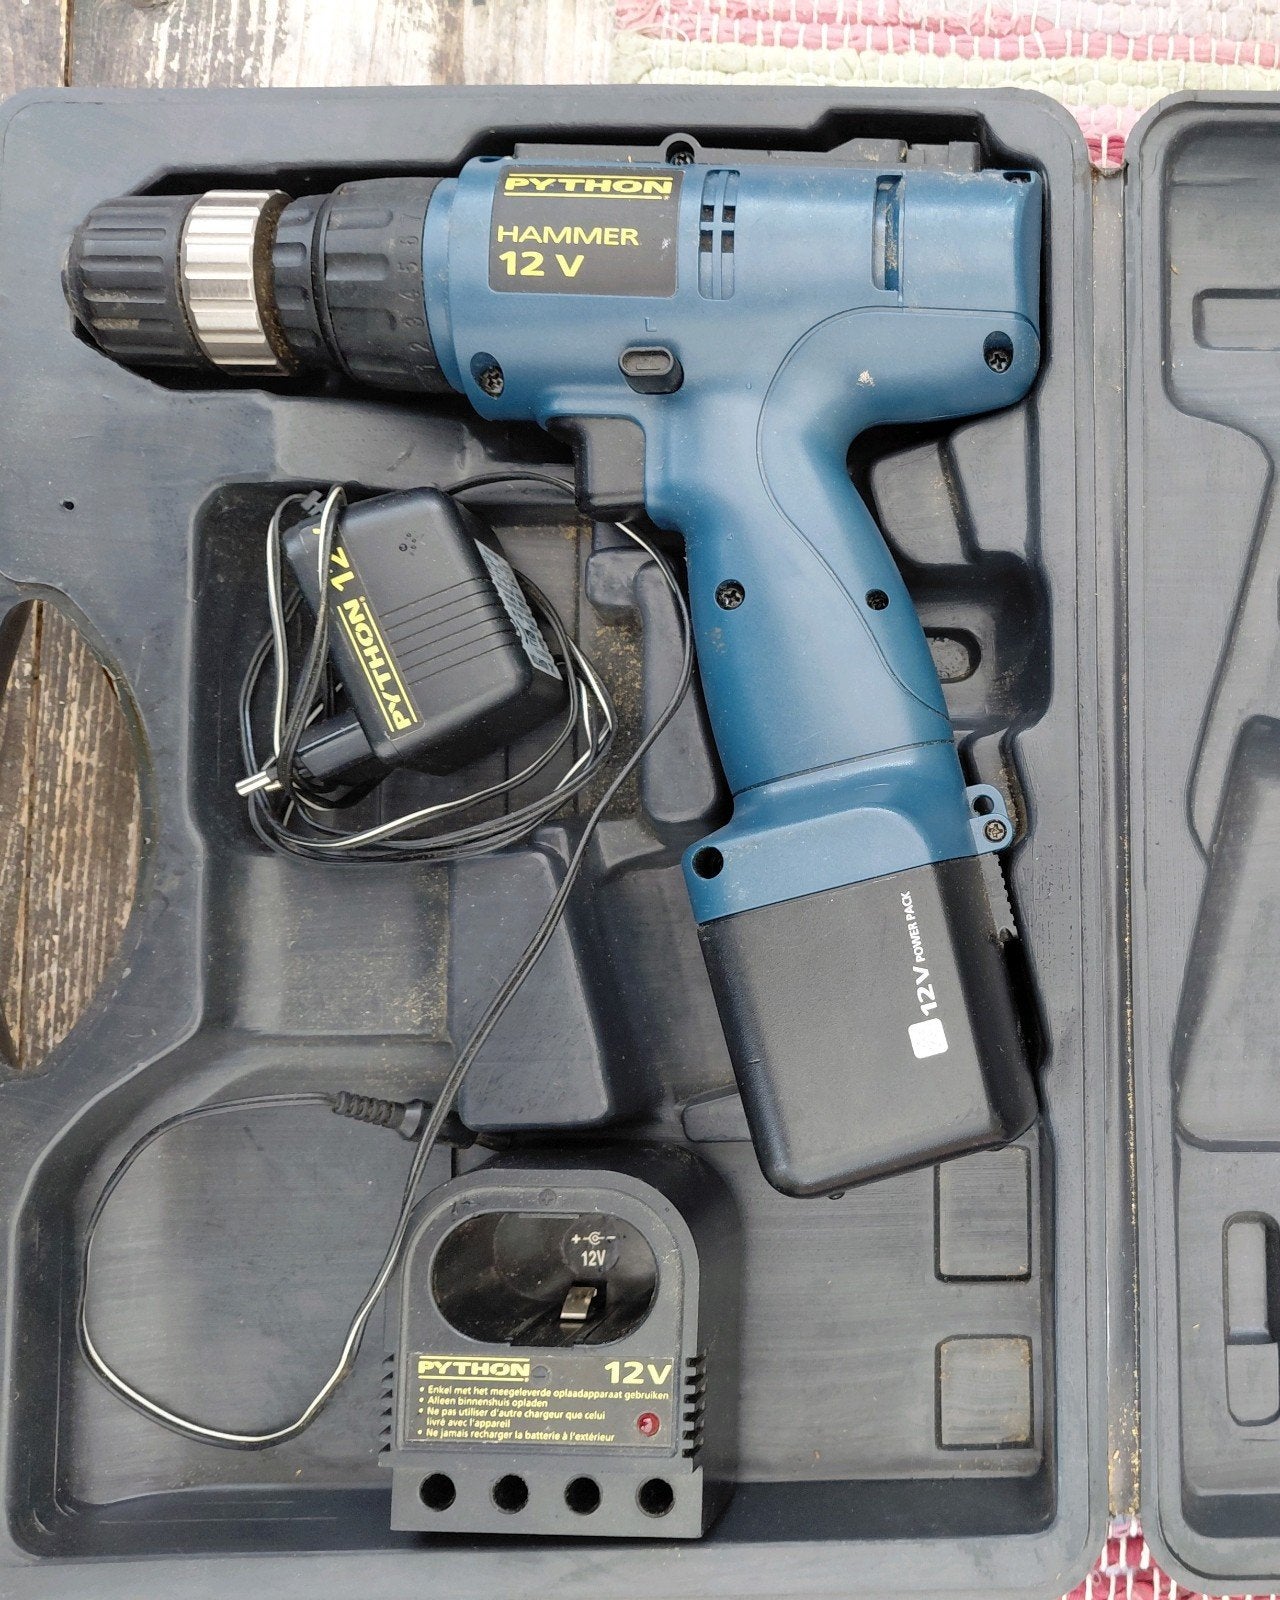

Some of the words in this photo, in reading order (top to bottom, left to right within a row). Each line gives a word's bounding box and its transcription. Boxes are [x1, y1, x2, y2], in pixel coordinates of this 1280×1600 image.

[504, 177, 674, 194] PYTHON
[496, 225, 640, 246] HAMMER
[499, 251, 545, 277] 12
[555, 254, 585, 278] V
[644, 316, 658, 333] L
[343, 598, 412, 731] PYTHON
[900, 890, 916, 921] PACK
[907, 921, 925, 963] POWER
[580, 1250, 606, 1267] 12V
[417, 1361, 530, 1377] PYTHON
[427, 1384, 453, 1396] Enkel
[454, 1386, 472, 1396] met
[473, 1386, 489, 1396] het
[490, 1387, 551, 1399] meegeleverde
[553, 1388, 623, 1400] oplaadapparaat
[624, 1390, 669, 1402] gebruiken
[427, 1395, 456, 1406] Alleen
[457, 1396, 510, 1407] binnenshuis
[511, 1398, 548, 1409] opladen
[426, 1406, 440, 1416] Ne
[441, 1408, 457, 1418] pas
[458, 1407, 488, 1417] utiliser
[524, 1409, 564, 1421] chargeur
[565, 1411, 583, 1421] que
[584, 1410, 606, 1420] celui
[426, 1417, 446, 1427] livré
[447, 1418, 468, 1428] avec
[426, 1428, 439, 1438] Ne
[440, 1428, 469, 1439] jamais
[470, 1429, 512, 1441] recharger
[514, 1430, 523, 1440] la
[524, 1430, 561, 1441] batterie
[561, 1431, 568, 1441] à
